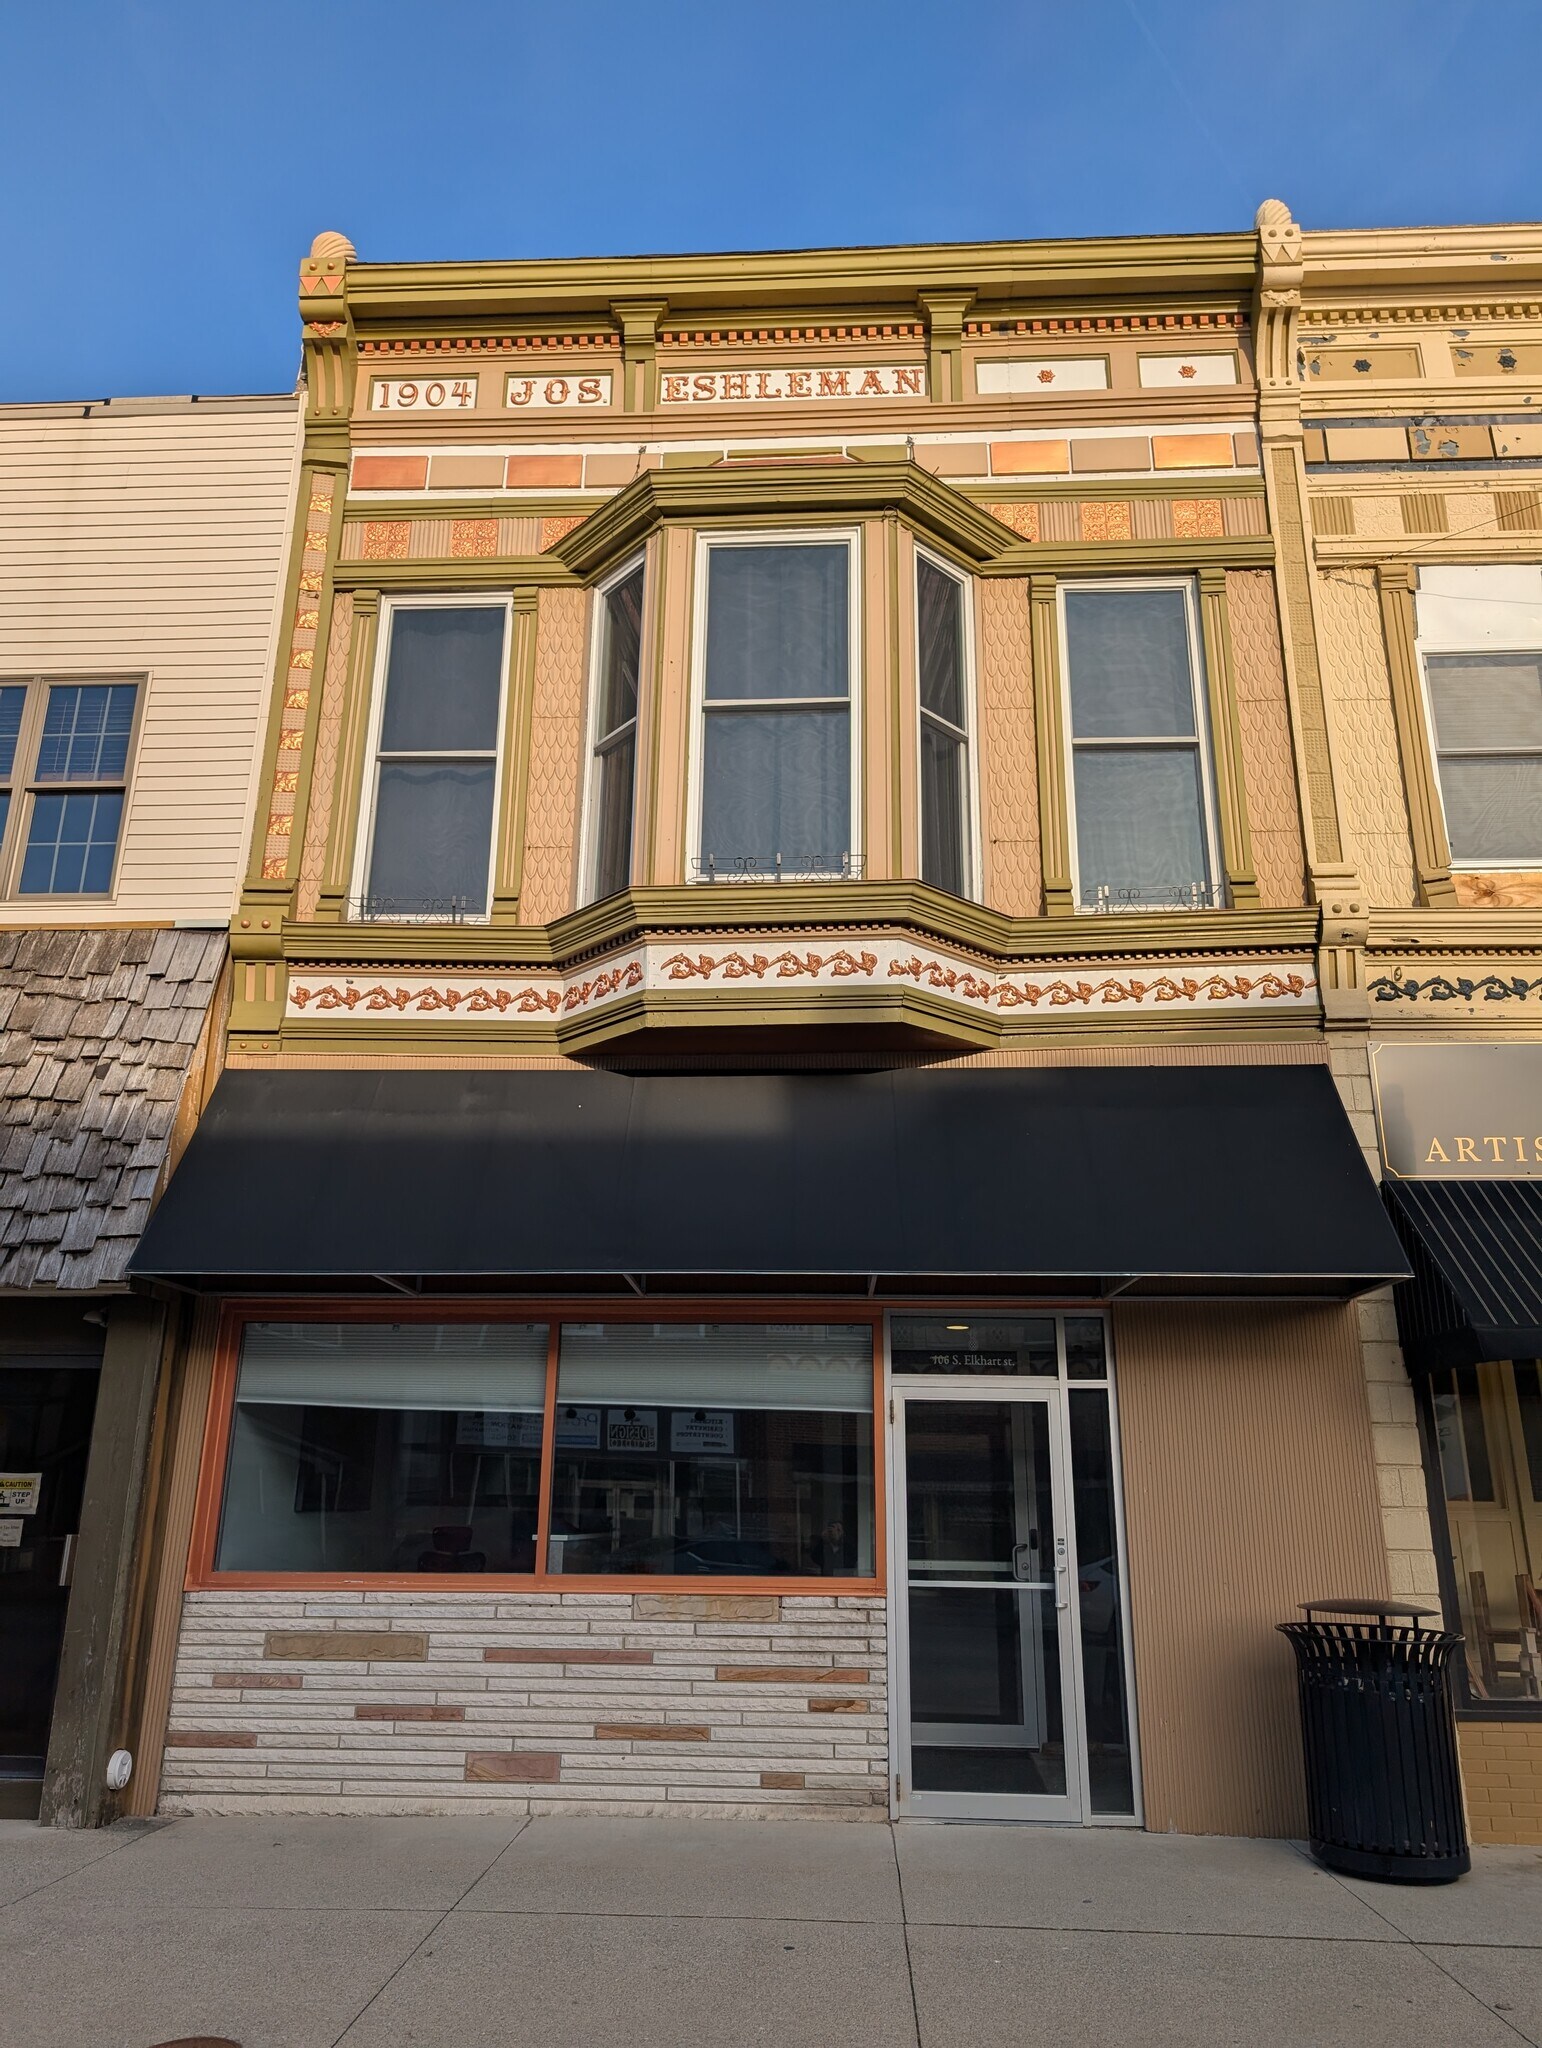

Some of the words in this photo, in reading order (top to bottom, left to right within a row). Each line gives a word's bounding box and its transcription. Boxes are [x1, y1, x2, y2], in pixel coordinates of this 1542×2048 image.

[379, 381, 473, 409] 1904
[662, 368, 924, 403] ESHLEMAN
[964, 1354, 1001, 1366] Elkhart
